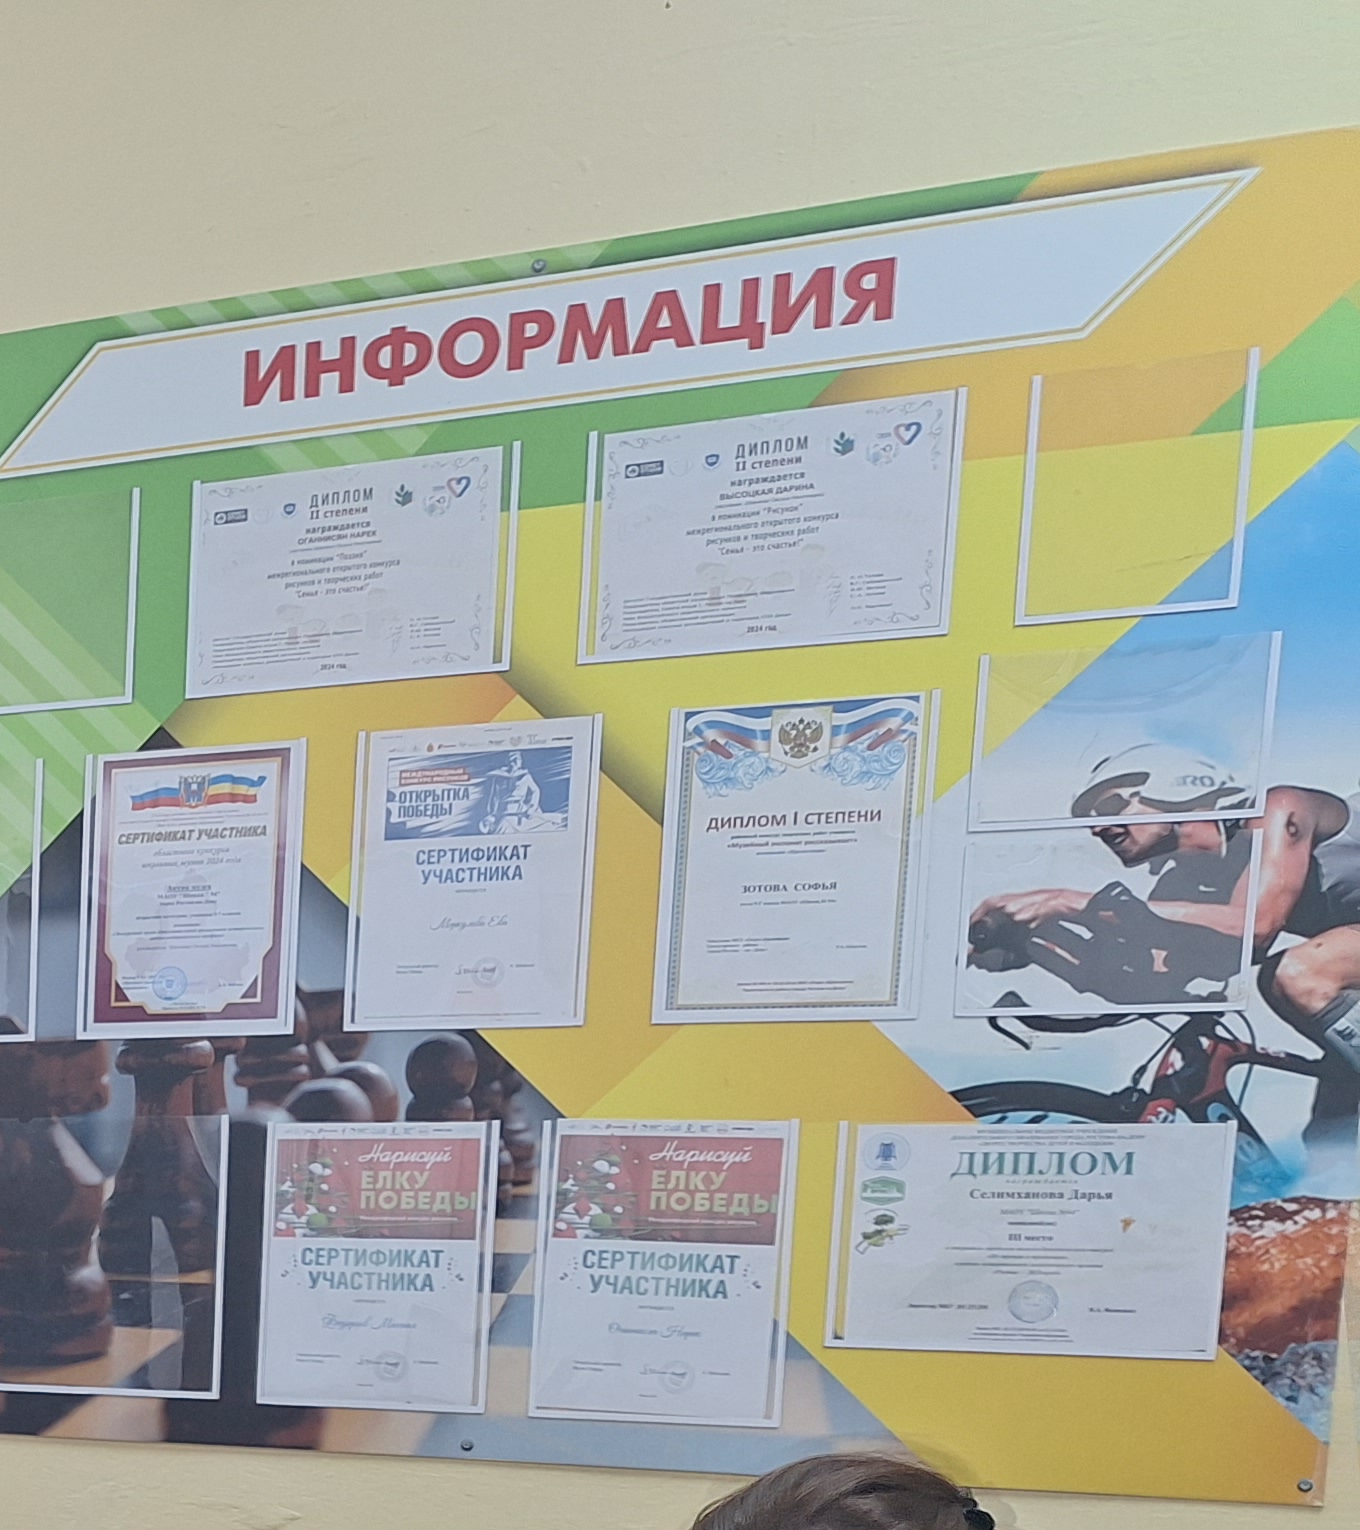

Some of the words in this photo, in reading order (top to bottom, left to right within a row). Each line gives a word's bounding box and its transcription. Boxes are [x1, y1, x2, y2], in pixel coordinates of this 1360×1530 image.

[241, 256, 898, 408] ИНФОРМАЦИЯ
[735, 435, 808, 460] ДИПЛОМ
[735, 460, 747, 472] II
[751, 456, 802, 470] степени
[730, 471, 806, 487] награждается
[308, 487, 374, 509] ДИПЛОМ
[719, 487, 775, 501] ВЫСОЦКАЯ
[775, 482, 816, 495] ДАРИНА
[309, 510, 320, 521] II
[323, 505, 368, 519] степени
[305, 520, 371, 535] награждается
[399, 787, 470, 804] ОТКРЫТКА
[398, 803, 453, 819] ПОБЕДЫ
[706, 814, 787, 833] ДИПЛОМ
[793, 811, 798, 826] I
[804, 809, 882, 825] СТЕПЕНИ
[117, 829, 195, 845] СЕРТИФИКАТ
[196, 825, 268, 841] УЧАСТНИКА
[416, 844, 532, 866] СЕРТИФИКАТ
[421, 865, 523, 885] УЧАСТНИКА
[741, 884, 788, 894] ЗОТОВА
[793, 881, 837, 892] СОФЬЯ
[358, 1143, 452, 1169] Нарисуй
[649, 1140, 753, 1170] Нарисуй
[950, 1151, 1135, 1180] ДИПЛОМ
[360, 1191, 477, 1213] ПОБЕДЫ
[649, 1191, 779, 1216] ПОБЕДЫ
[969, 1188, 1065, 1200] Селимханова
[1067, 1188, 1114, 1203] Дарья
[300, 1247, 445, 1269] СЕРТИФИКАТ
[582, 1249, 741, 1274] СЕРТИФИКАТ
[308, 1271, 435, 1292] УЧАСТНИКА
[589, 1274, 729, 1300] УЧАСТНИКА
